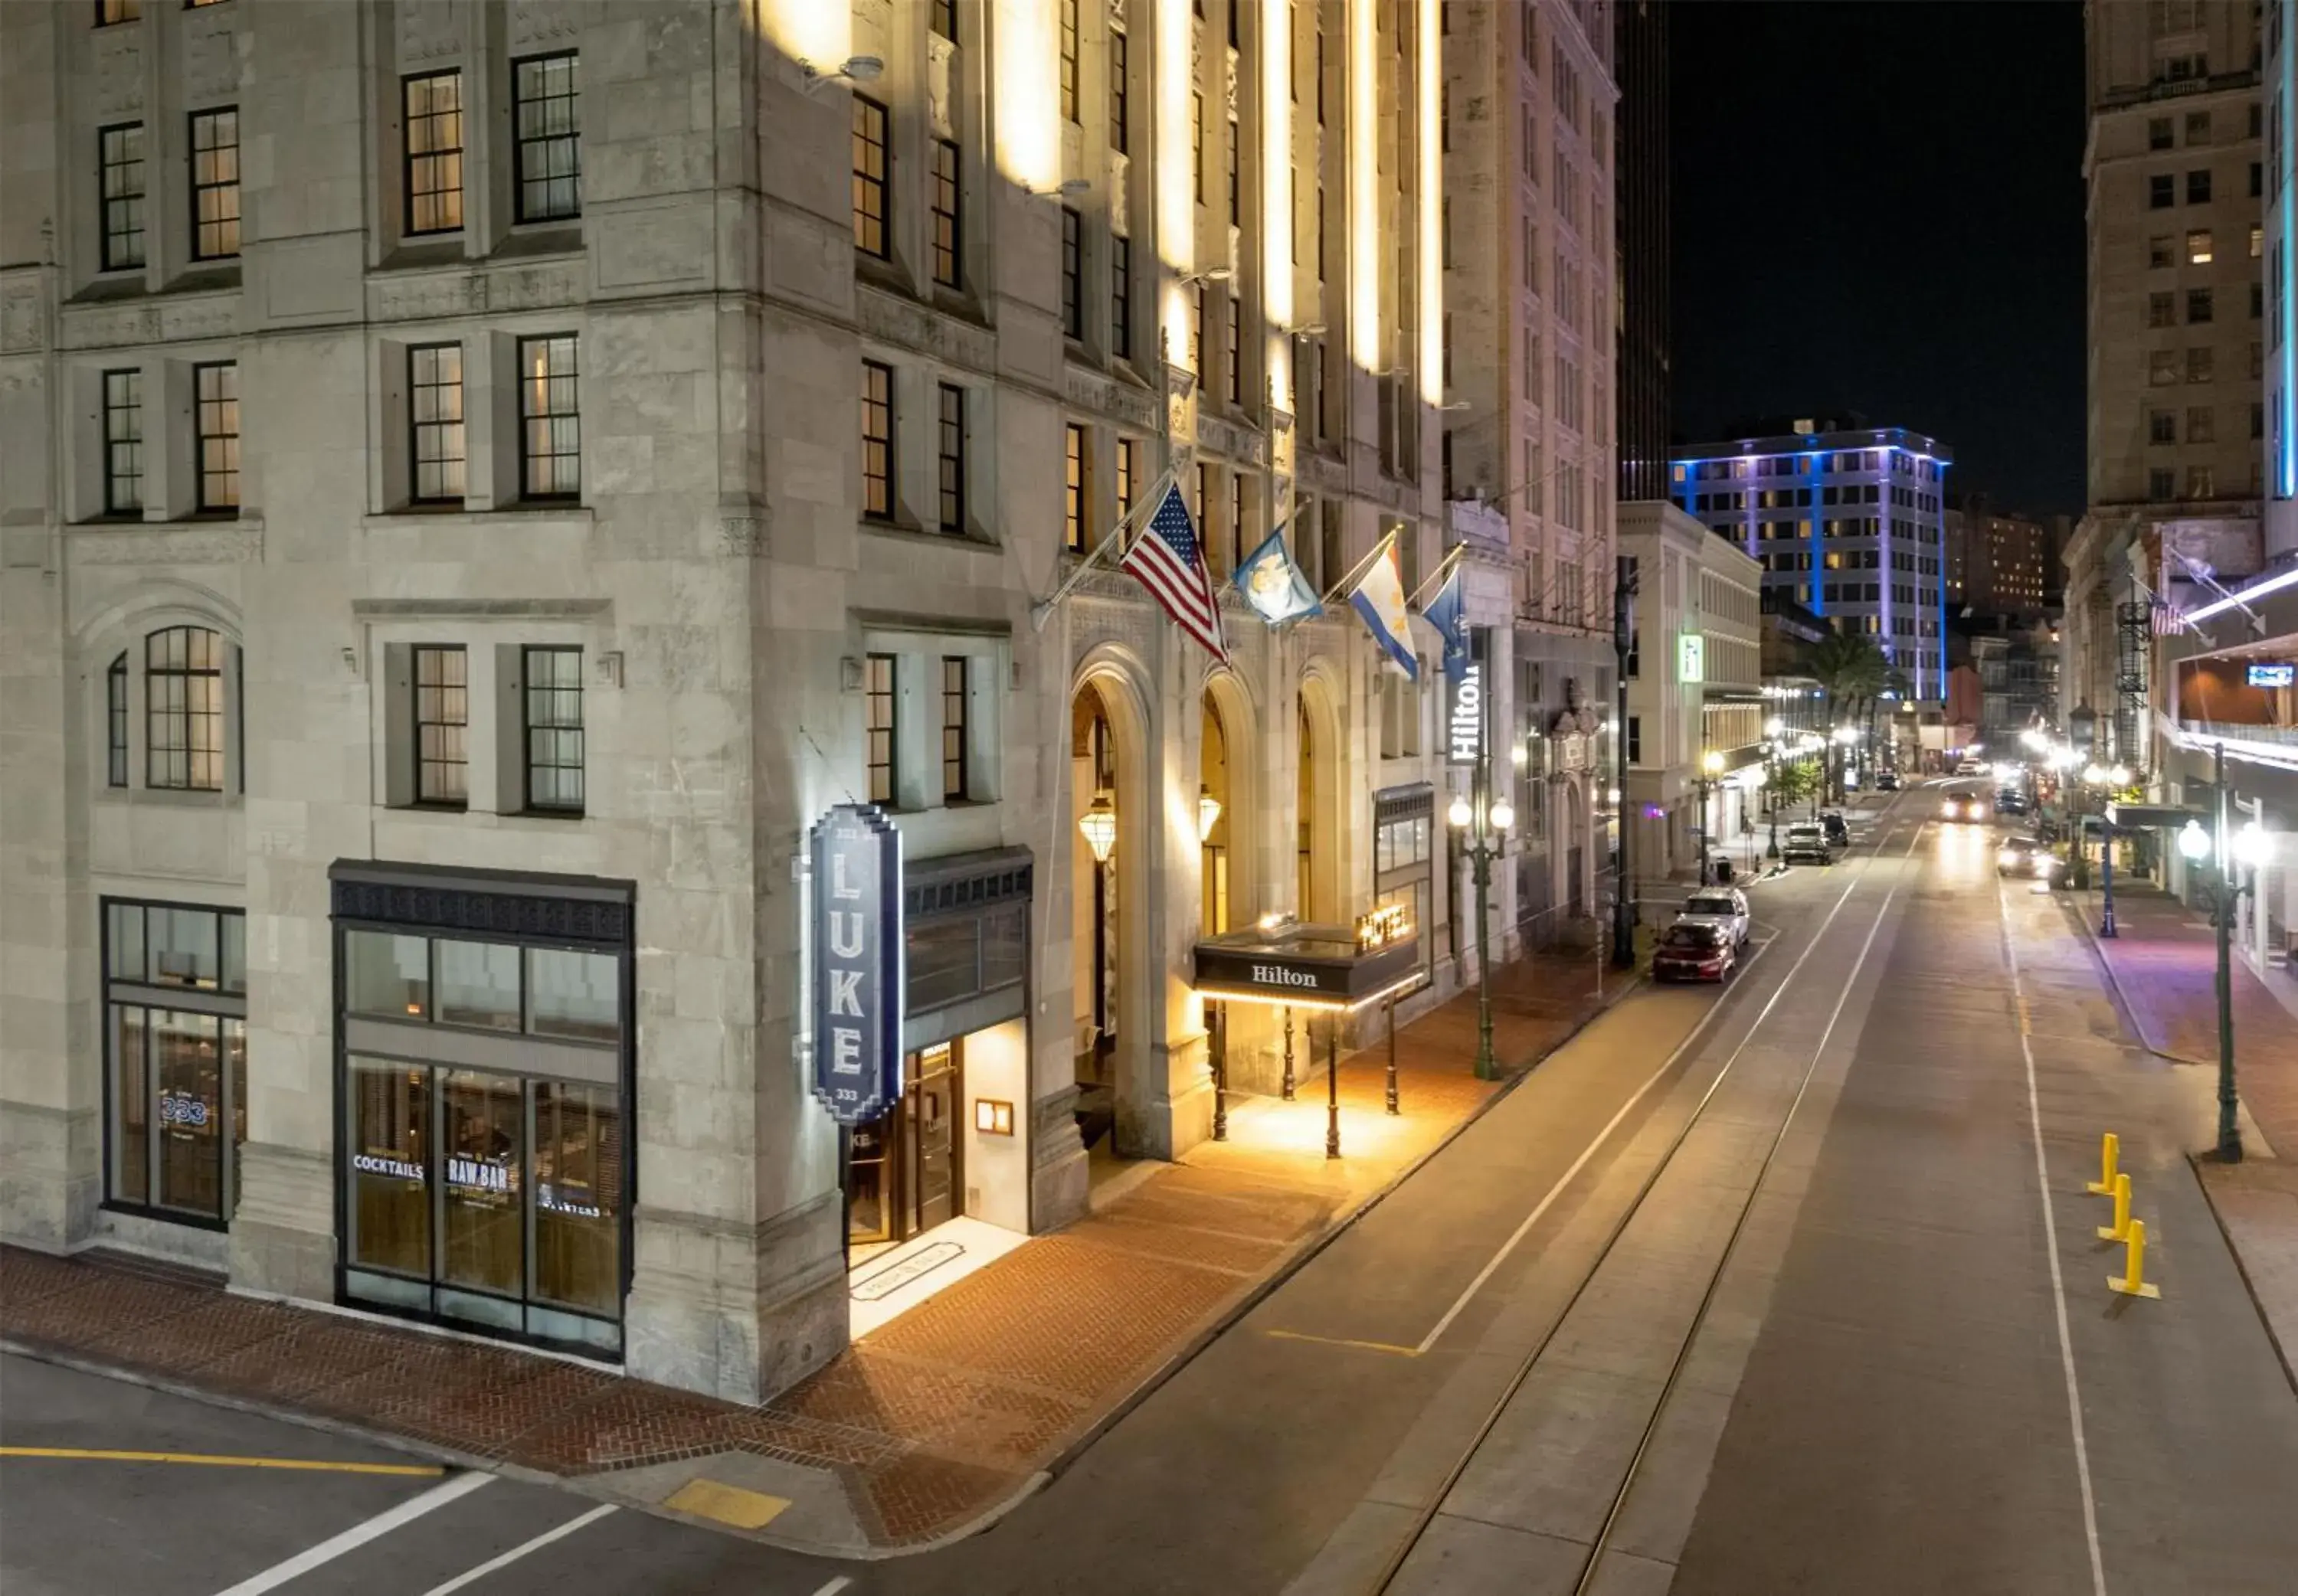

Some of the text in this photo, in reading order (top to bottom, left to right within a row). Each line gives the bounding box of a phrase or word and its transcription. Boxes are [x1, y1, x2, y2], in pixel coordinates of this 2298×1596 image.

[1451, 666, 1479, 760] Hilton
[1361, 904, 1409, 950] HOTEL
[829, 853, 866, 1074] LUKE
[1252, 965, 1318, 987] Hilton
[834, 1088, 858, 1101] 333
[162, 1097, 207, 1125] 333
[353, 1154, 424, 1180] COCKTAILS
[449, 1159, 508, 1189] RAW BAR
